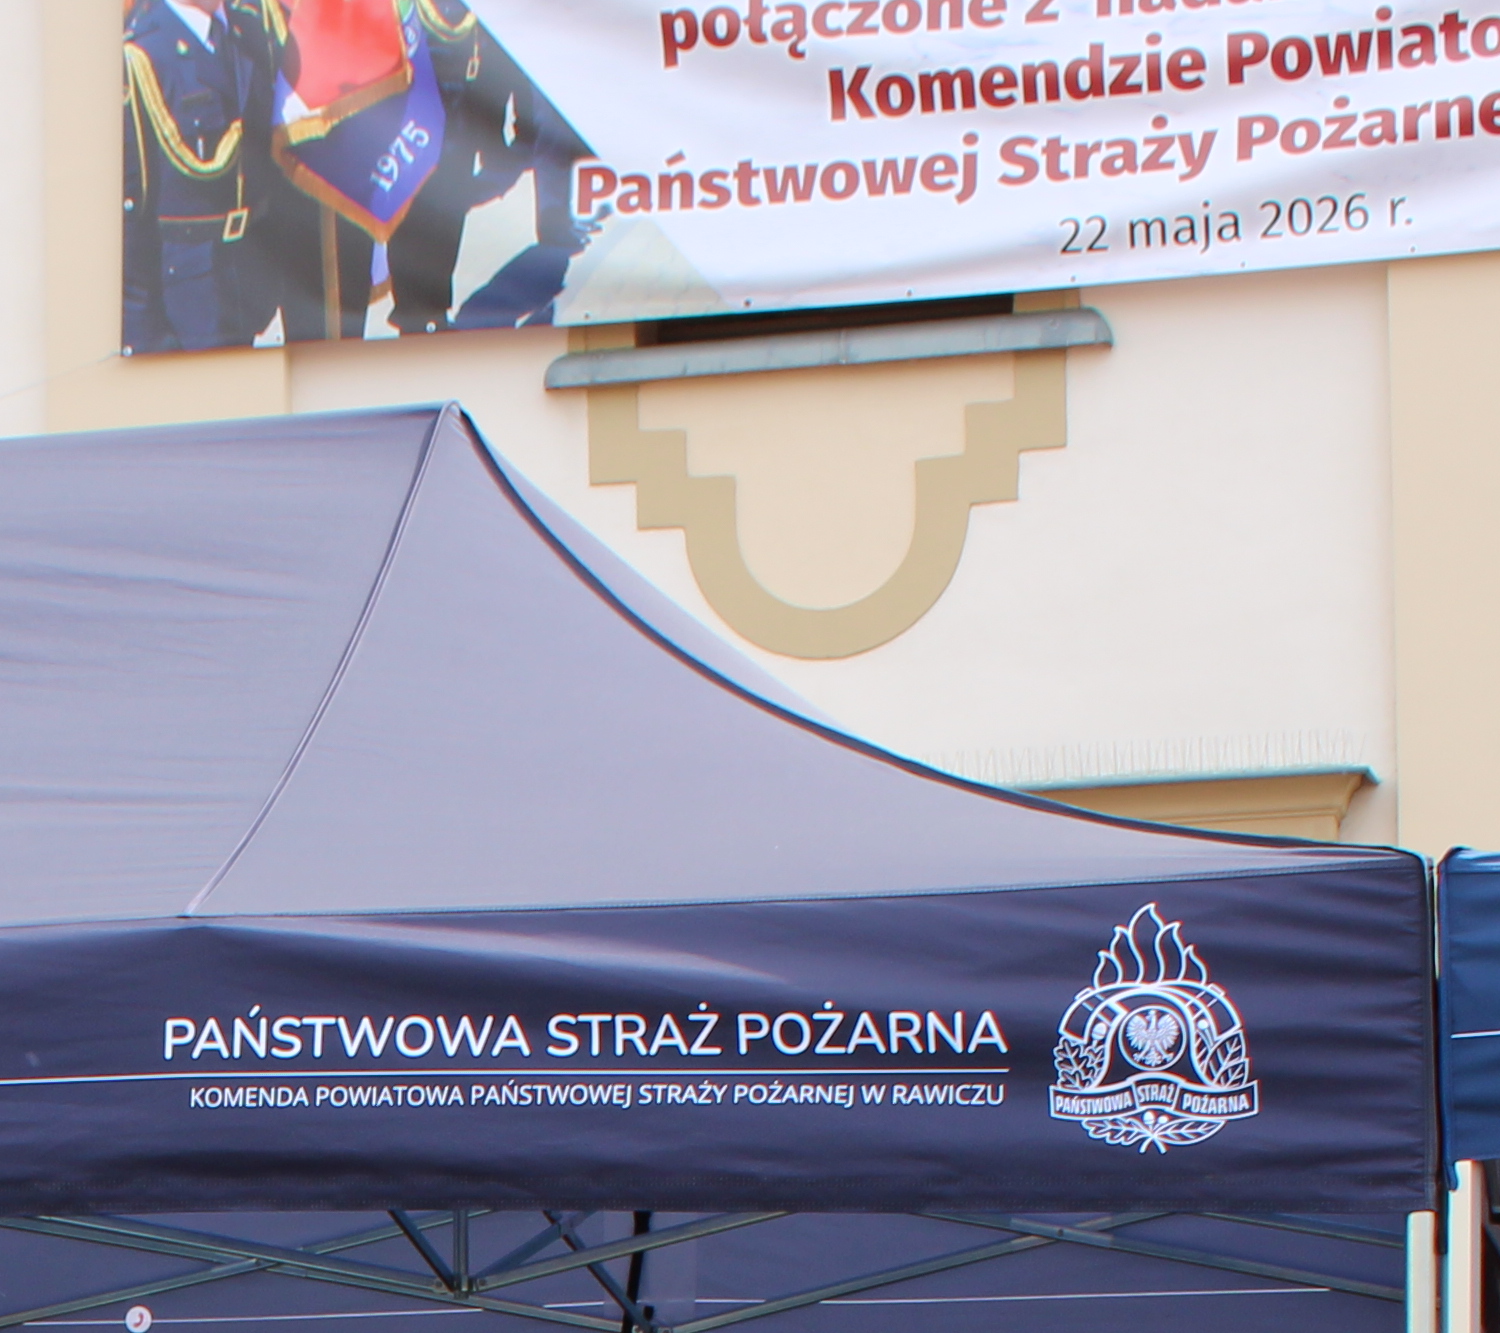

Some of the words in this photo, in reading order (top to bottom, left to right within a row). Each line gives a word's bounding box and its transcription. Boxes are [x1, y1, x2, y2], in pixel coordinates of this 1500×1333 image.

[660, 0, 1002, 68] połączone
[828, 33, 1207, 122] Komendzie
[369, 119, 431, 192] 1975
[574, 130, 979, 219] Państwowej
[998, 115, 1218, 184] Straży
[1058, 215, 1110, 256] 22
[1126, 199, 1241, 254] maja
[1258, 192, 1370, 241] 2026
[1387, 194, 1414, 228] r.
[163, 1003, 533, 1061] PAŃSTWOWA
[547, 1001, 722, 1058] STRAŻ
[736, 1000, 1010, 1056] POŻARNA
[189, 1085, 309, 1109] KOMENDA
[315, 1084, 464, 1108] POWIATOWA
[470, 1079, 632, 1109] PAŃSTWOWEJ
[638, 1080, 728, 1105] STRAŻY
[733, 1080, 856, 1109] POŻARNEJ
[861, 1085, 887, 1105] W
[892, 1084, 1005, 1107] RAWICZU
[1055, 1090, 1133, 1115] PAŃSTWOWA
[1136, 1082, 1178, 1104] STRAŻ
[1181, 1091, 1250, 1115] POŻARNA
